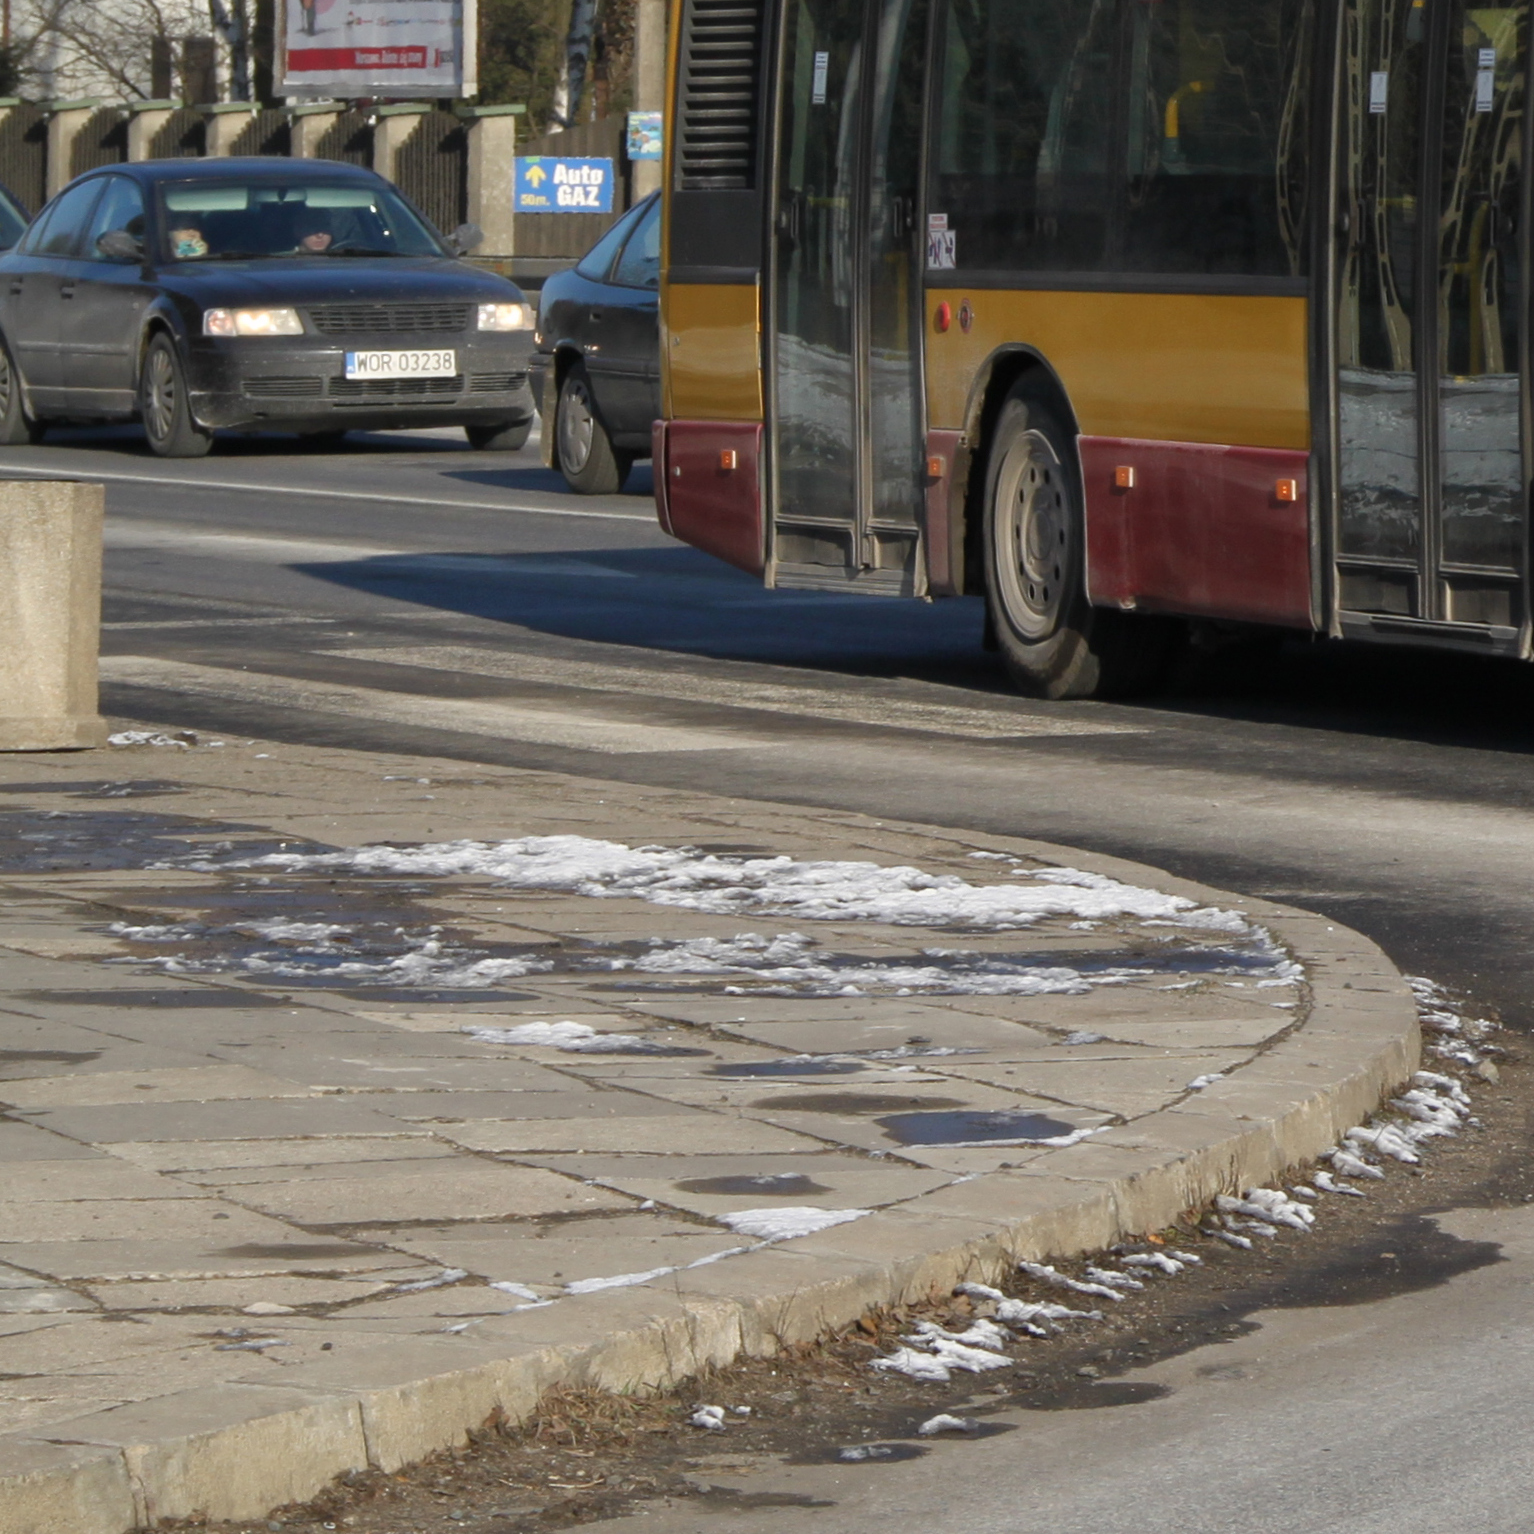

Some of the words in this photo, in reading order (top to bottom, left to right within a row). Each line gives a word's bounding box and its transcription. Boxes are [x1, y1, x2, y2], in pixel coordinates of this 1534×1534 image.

[553, 163, 604, 185] Auto
[557, 185, 600, 206] GAZ
[357, 353, 392, 372] WOR
[398, 352, 453, 372] 03238
